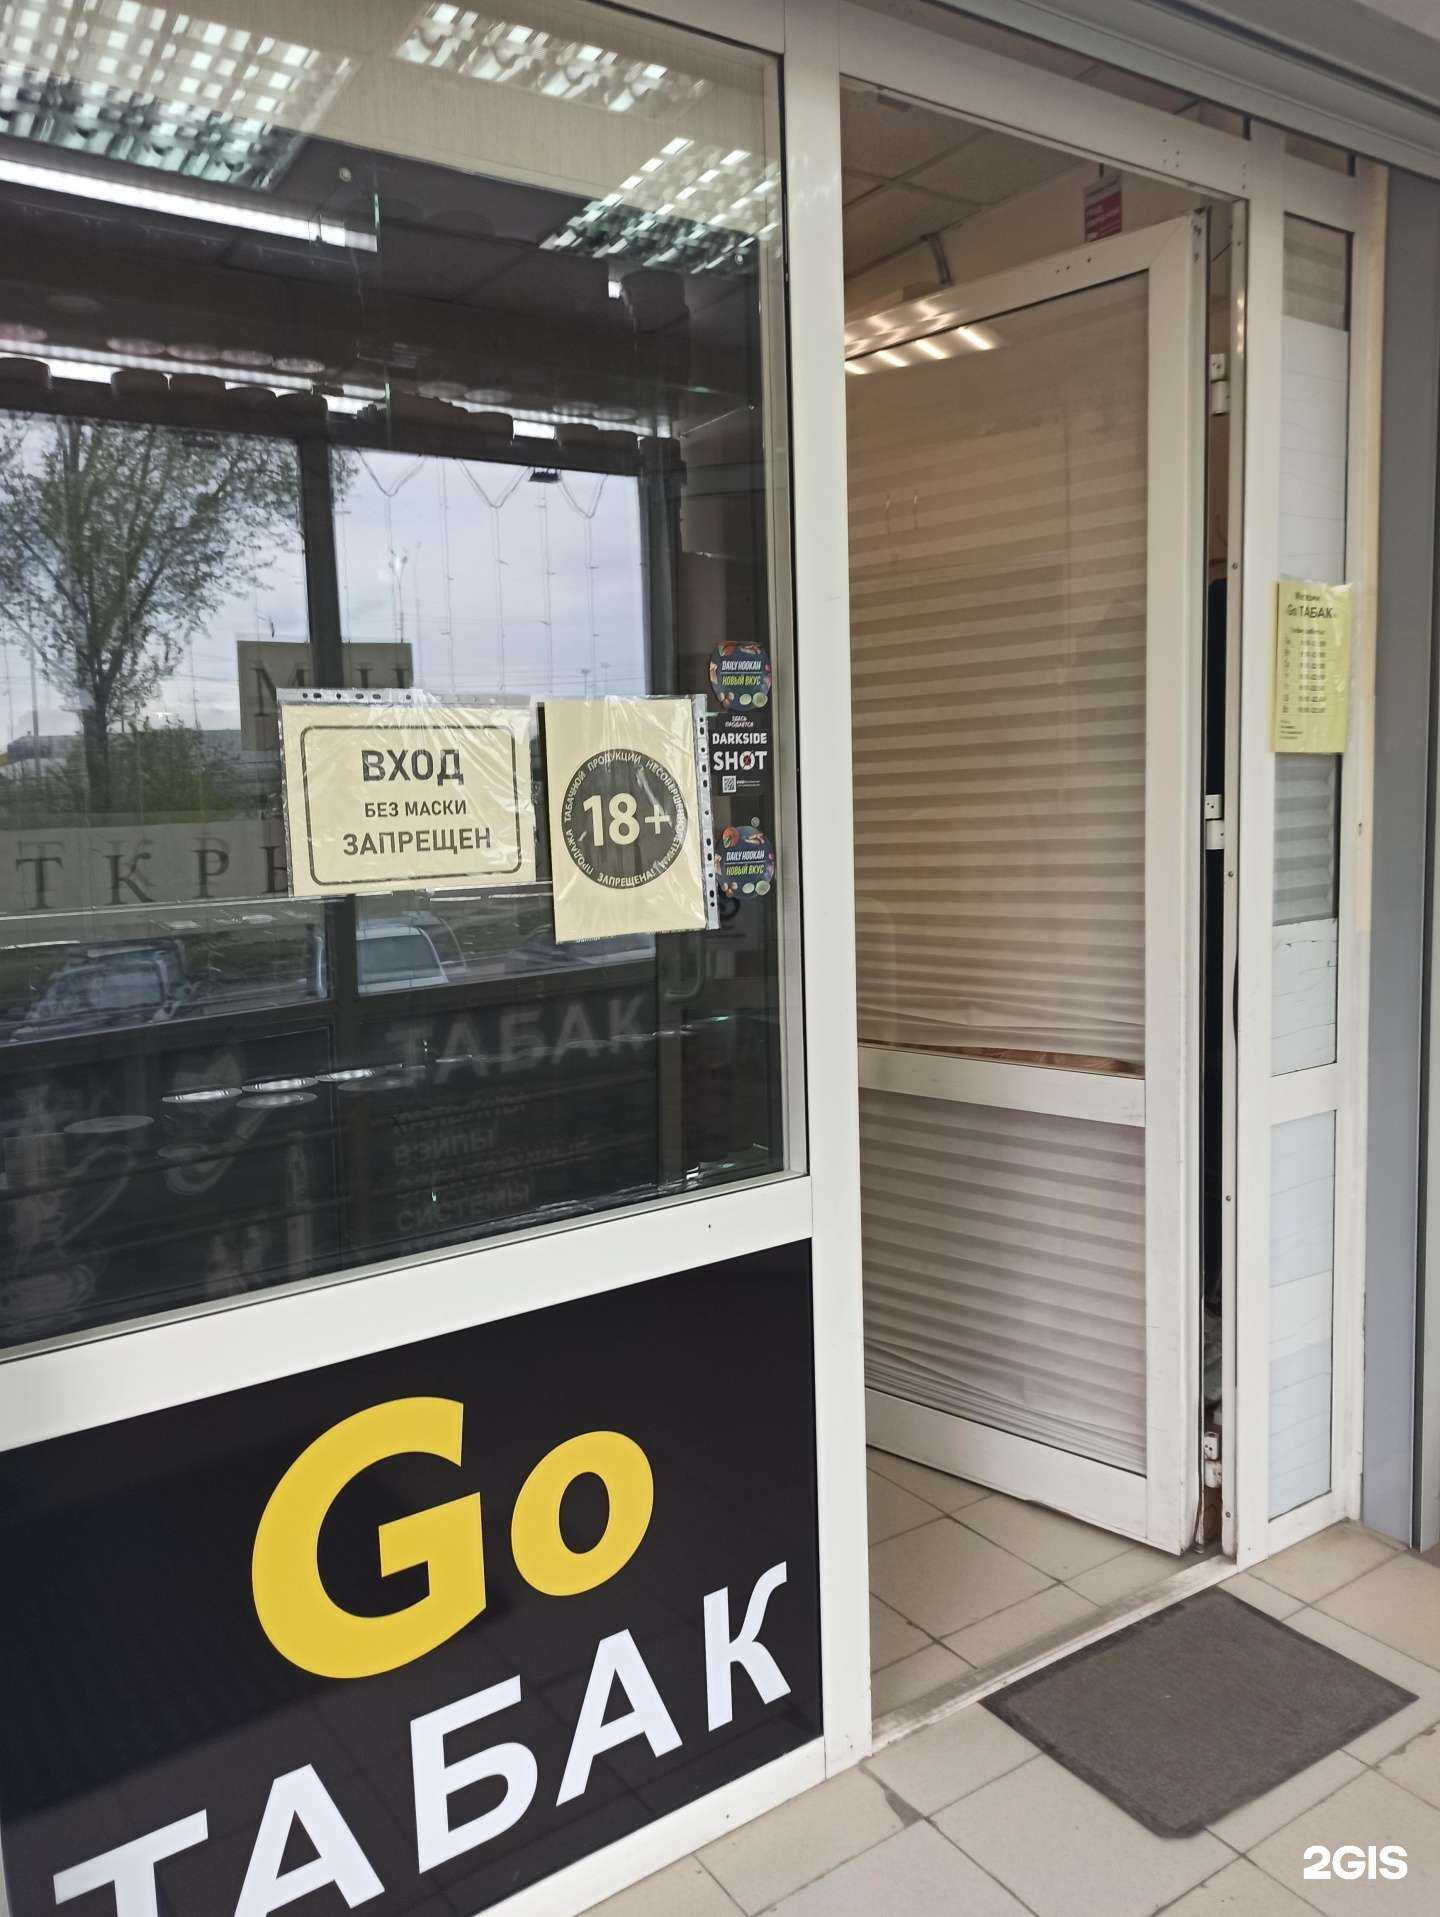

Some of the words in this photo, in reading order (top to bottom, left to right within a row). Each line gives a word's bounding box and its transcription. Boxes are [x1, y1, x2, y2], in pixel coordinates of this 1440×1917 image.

[712, 732, 768, 745] DARKSIDE
[361, 749, 465, 787] ВХОД
[587, 751, 642, 772] ПРОДУКЦИИ
[713, 751, 768, 771] SHOT
[364, 802, 400, 818] БЕЗ
[404, 800, 468, 817] МАСКИ
[564, 770, 588, 823] ТАБАЧНОЙ
[582, 792, 671, 848] 18+
[342, 827, 492, 856] ЗАПРЕЩЕН
[565, 827, 595, 875] ПРОДАЖА
[252, 1396, 654, 1679] Go
[53, 1561, 793, 1917] ТАБАК
